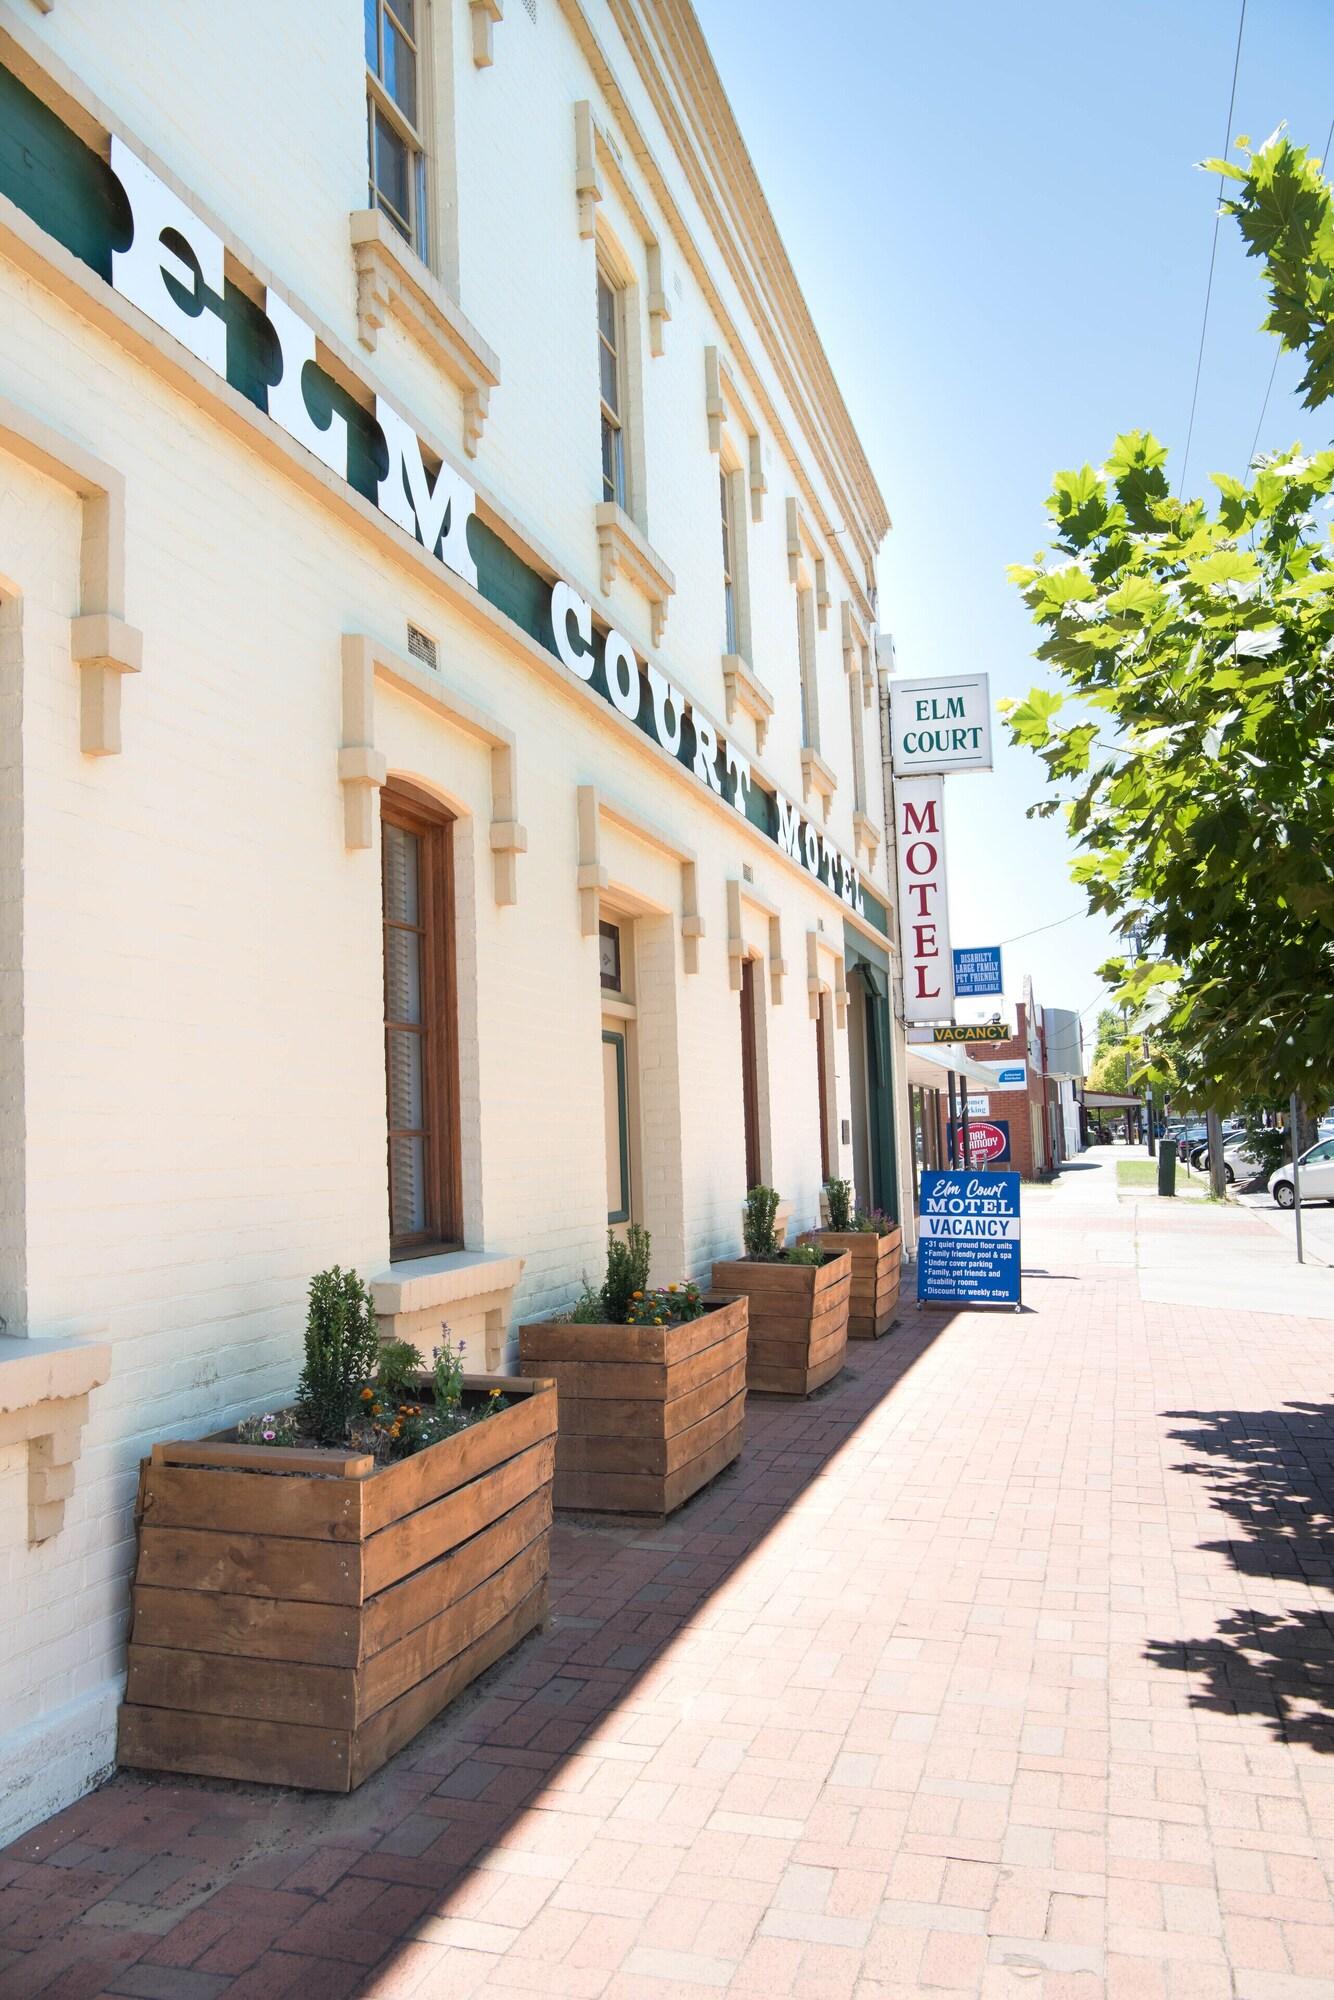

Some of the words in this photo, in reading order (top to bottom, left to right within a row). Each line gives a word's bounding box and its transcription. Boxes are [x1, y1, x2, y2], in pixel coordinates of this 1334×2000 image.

[111, 133, 479, 591] ELM
[551, 580, 751, 816] COURT
[776, 791, 865, 917] MOTEL
[916, 696, 965, 721] ELM
[903, 727, 983, 754] COURT
[902, 800, 940, 999] MOTEL
[955, 963, 975, 973] LARGE
[976, 961, 998, 972] FAMILY
[956, 973, 968, 983] PET
[969, 971, 999, 982] FRIENDLY
[974, 983, 999, 992] AVAILABLE
[935, 1026, 1007, 1041] VACANCY
[933, 1179, 961, 1198] Elm
[966, 1179, 1008, 1198] Court
[926, 1198, 1013, 1214] MOTEL
[929, 1219, 1010, 1236] VACANCY
[938, 1241, 955, 1249] quiet
[956, 1242, 978, 1250] ground
[928, 1250, 950, 1258] Family
[951, 1251, 975, 1259] friendly
[977, 1251, 991, 1259] pool
[1000, 1252, 1011, 1260] spa
[968, 1261, 993, 1269] parking
[952, 1269, 963, 1277] pet
[988, 1270, 1001, 1278] and
[927, 1277, 956, 1286] disability
[928, 1287, 956, 1295] Discount
[968, 1289, 990, 1297] weekly
[991, 1289, 1010, 1298] stays
